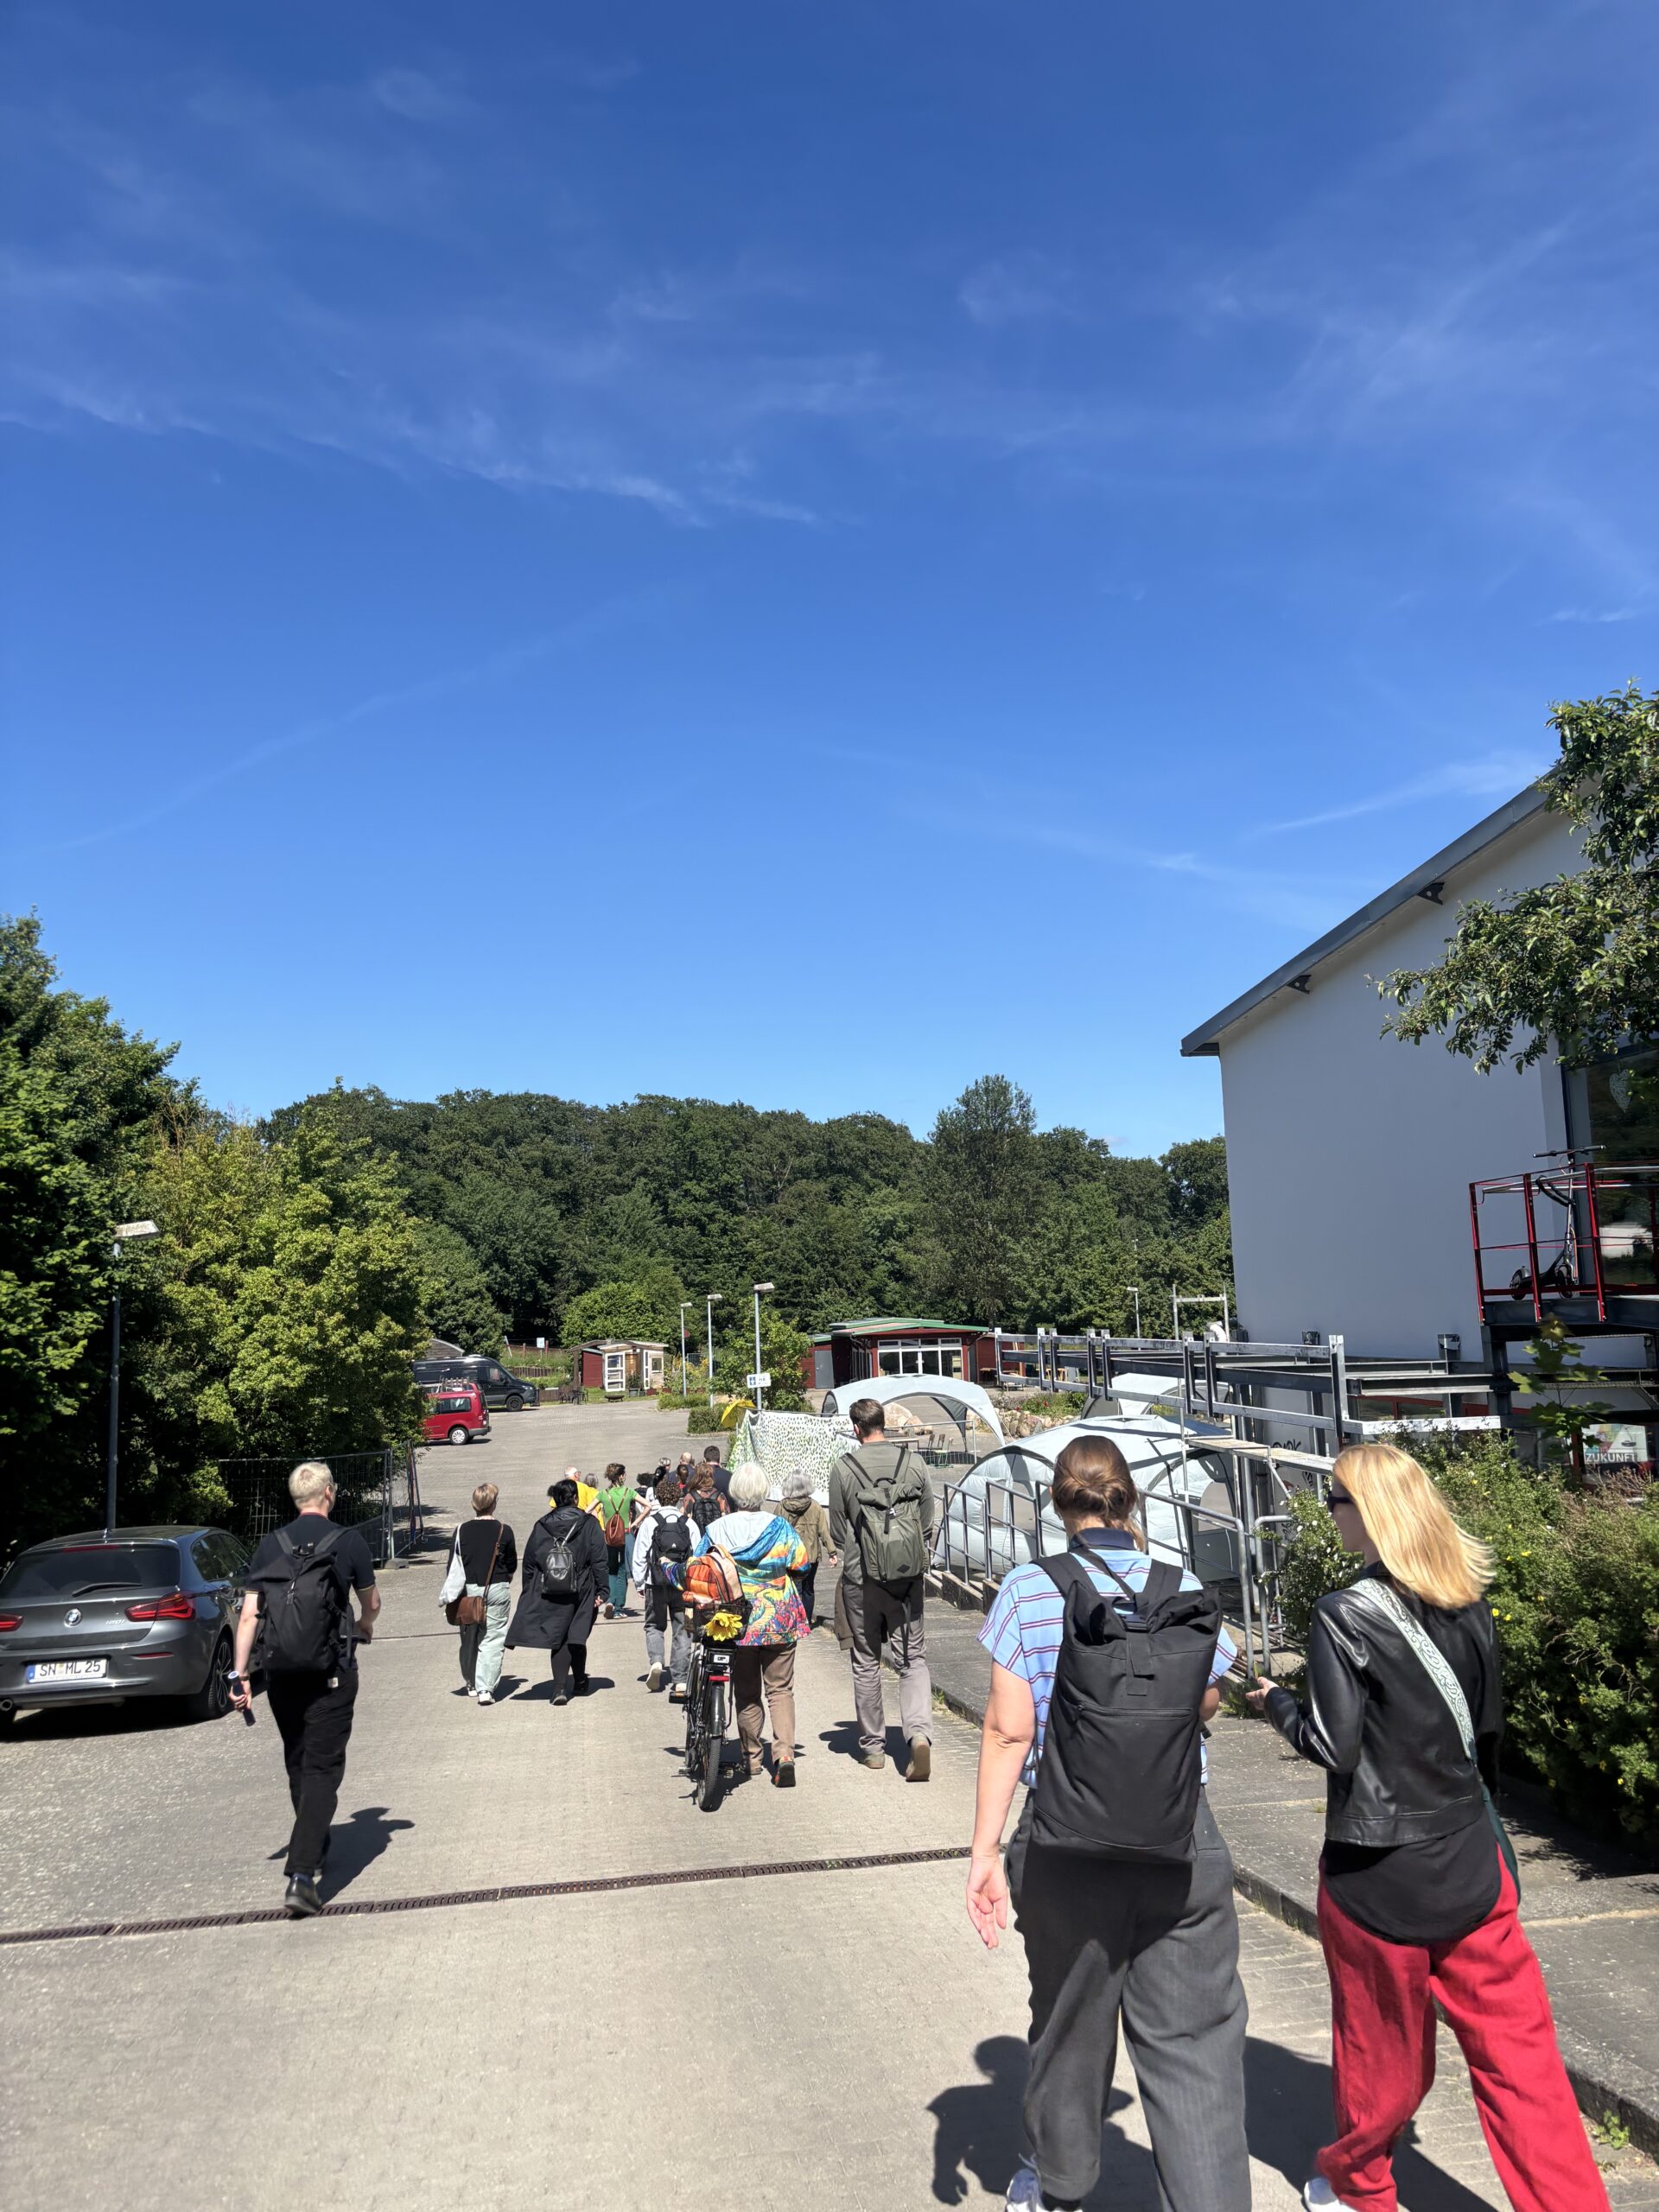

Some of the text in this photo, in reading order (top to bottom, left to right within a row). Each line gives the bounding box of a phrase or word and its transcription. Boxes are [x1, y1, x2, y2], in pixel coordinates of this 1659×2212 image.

[40, 1660, 101, 1677] SN ML 25
